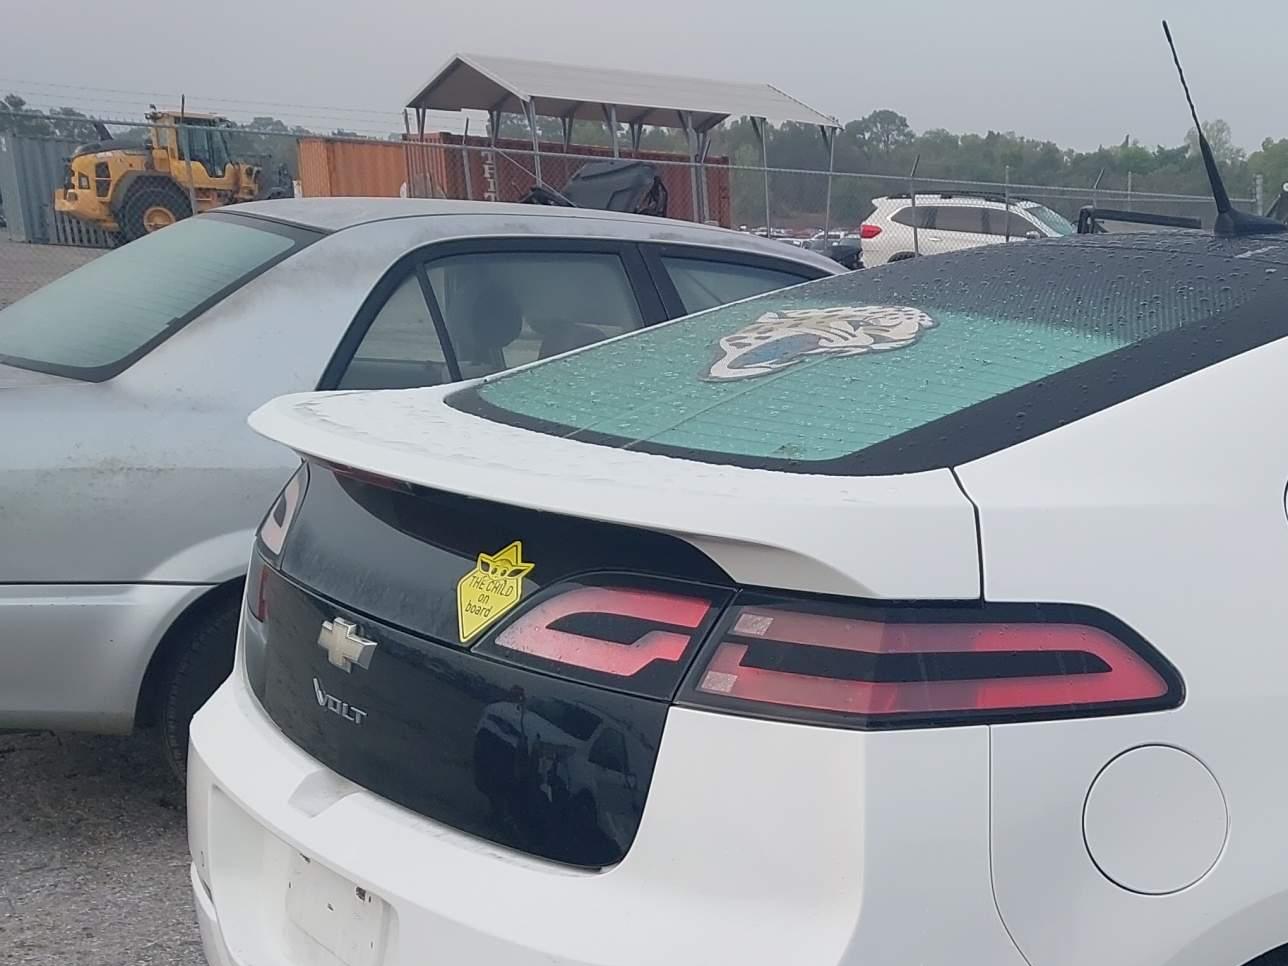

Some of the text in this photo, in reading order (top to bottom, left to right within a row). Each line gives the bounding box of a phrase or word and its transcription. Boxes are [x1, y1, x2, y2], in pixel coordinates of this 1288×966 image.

[469, 575, 514, 597] THE CHILD
[478, 593, 490, 604] on
[465, 600, 493, 618] board
[313, 677, 368, 724] VOLT
